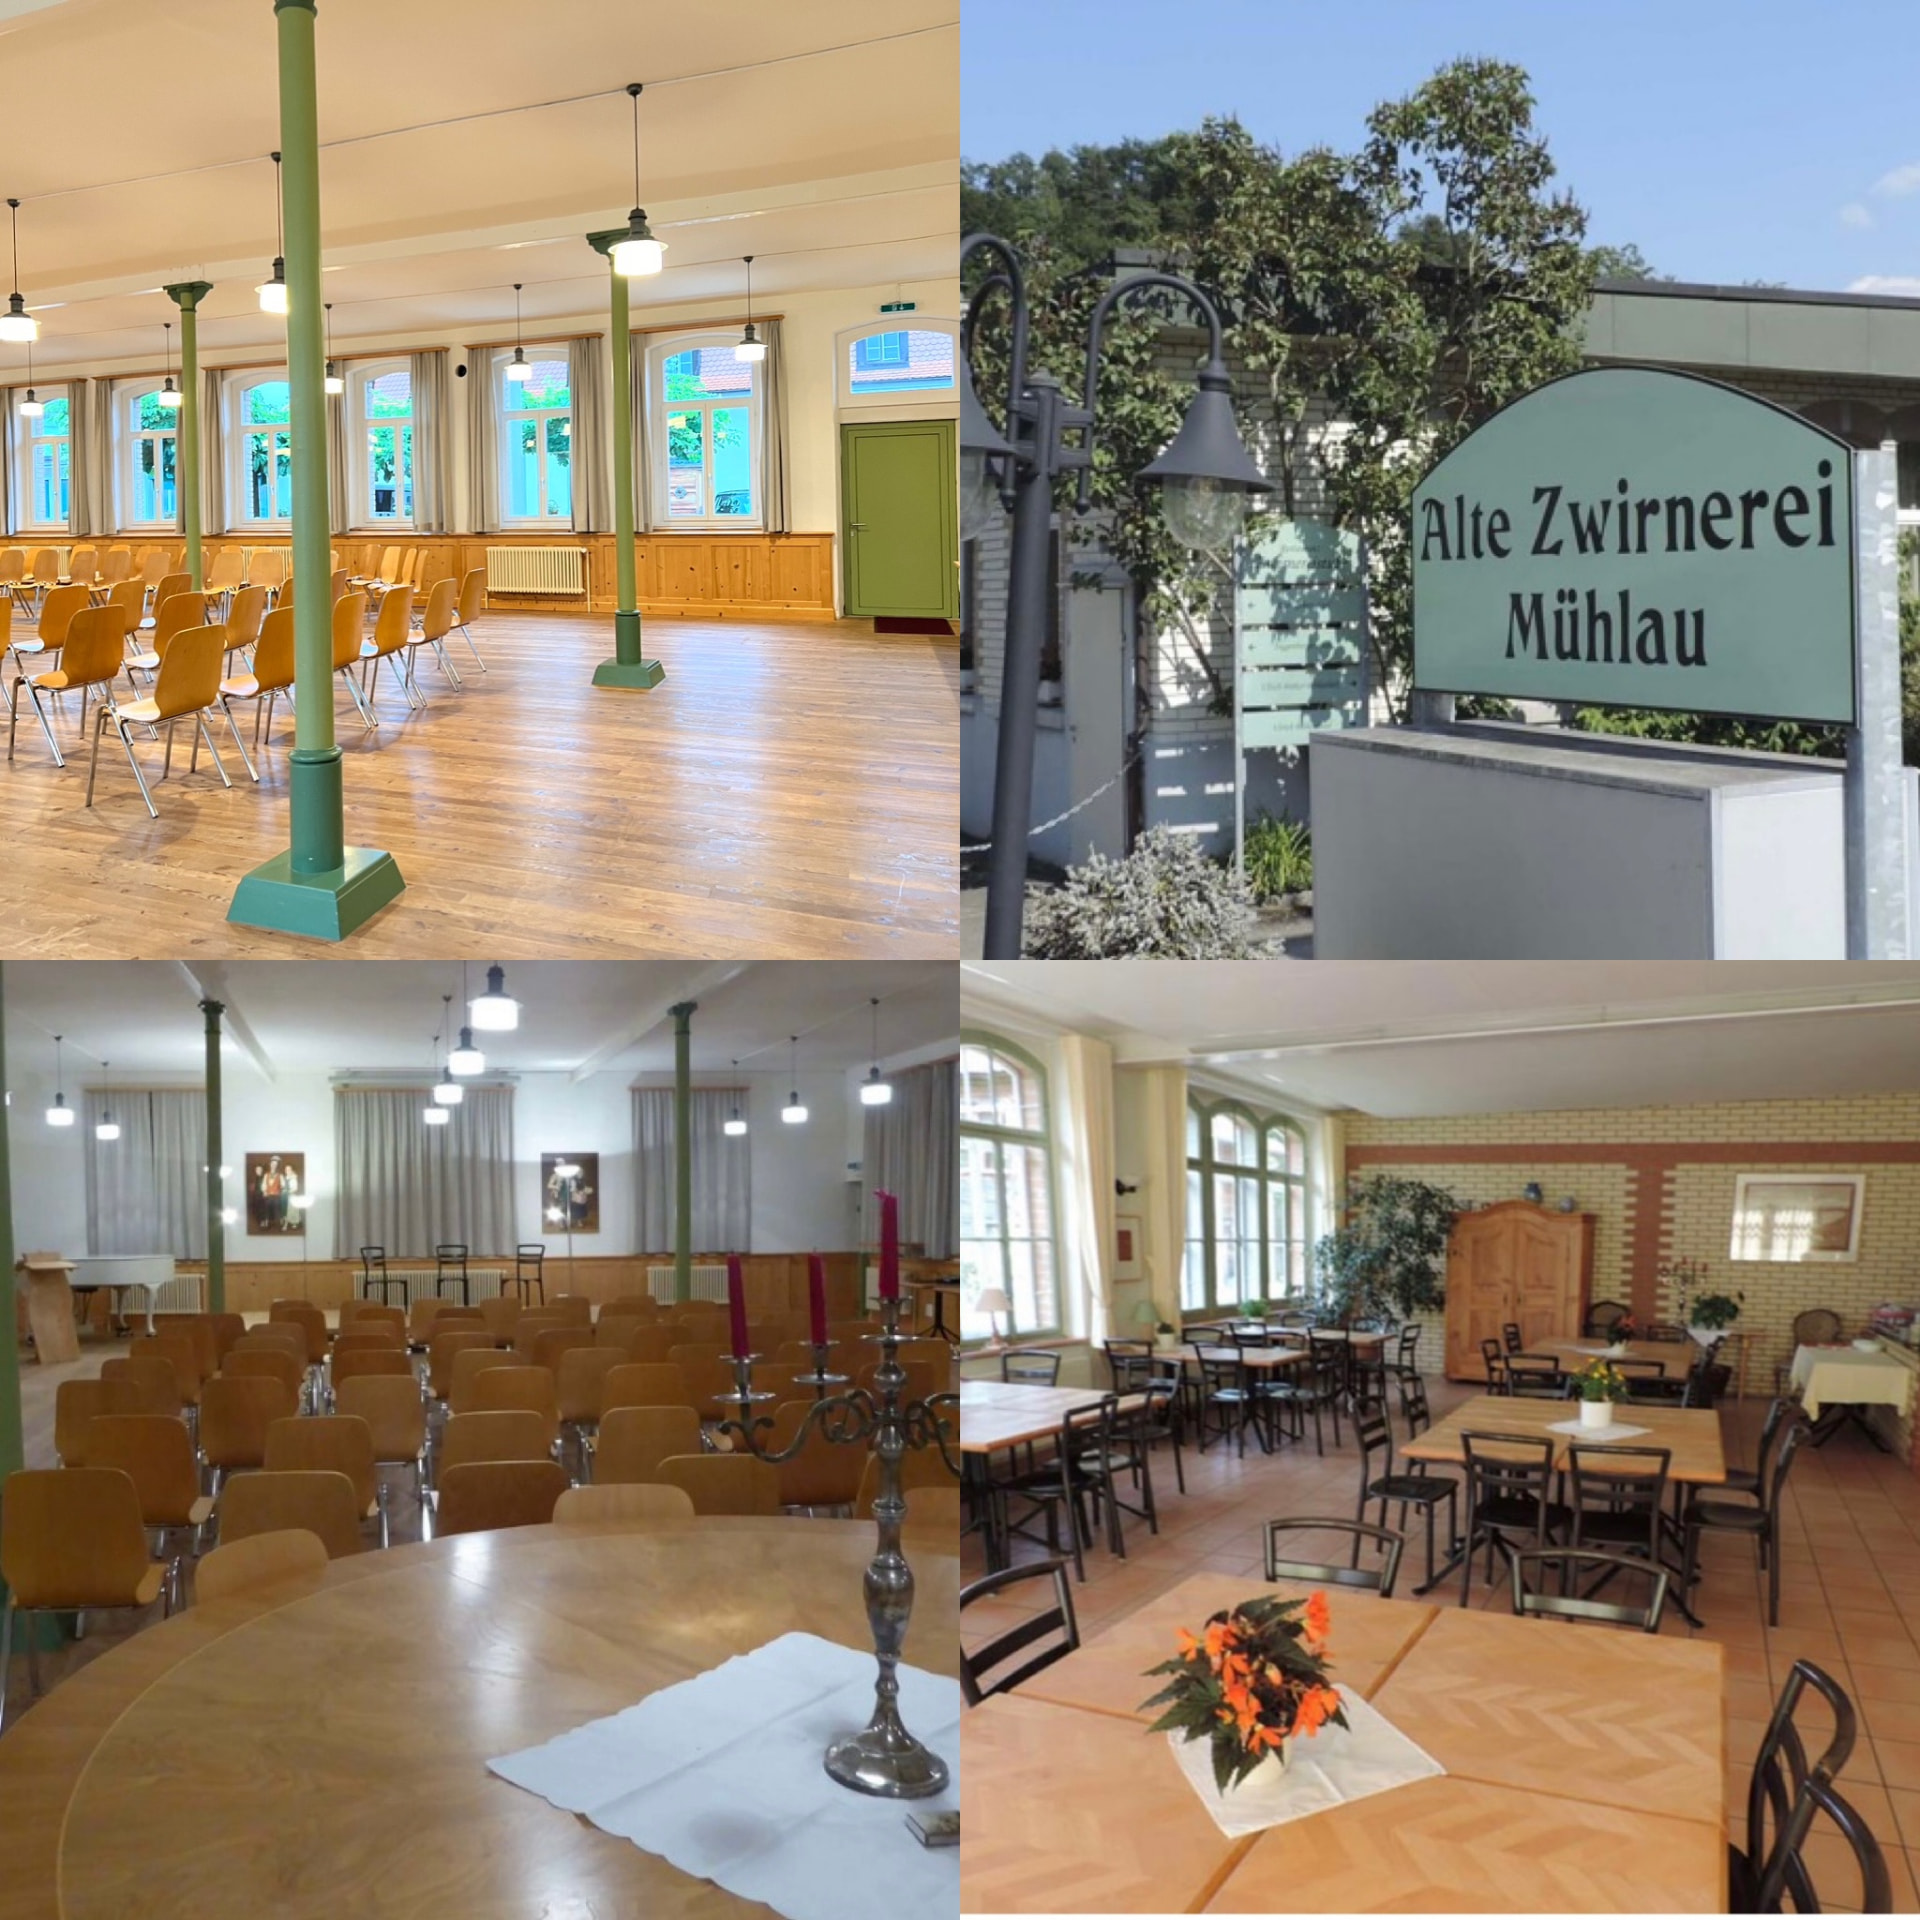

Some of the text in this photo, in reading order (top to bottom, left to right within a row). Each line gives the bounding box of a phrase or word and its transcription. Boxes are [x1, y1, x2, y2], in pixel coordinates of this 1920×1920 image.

[1421, 459, 1836, 561] Alte Zwirnerei
[1505, 588, 1706, 667] Mühlau
